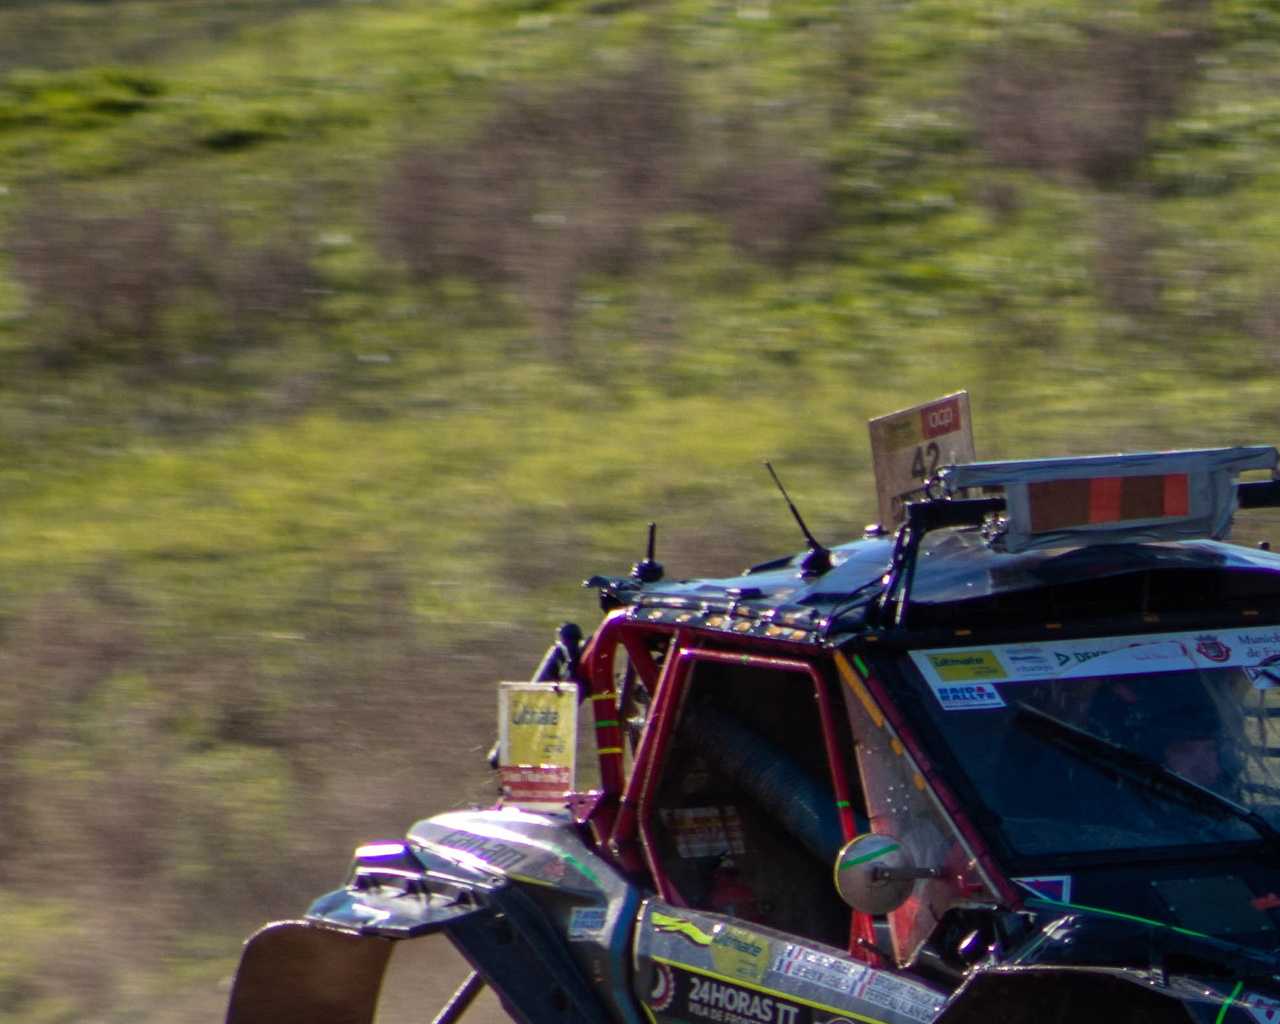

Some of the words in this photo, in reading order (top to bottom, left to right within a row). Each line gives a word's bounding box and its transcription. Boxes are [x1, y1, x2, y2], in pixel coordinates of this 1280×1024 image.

[911, 441, 940, 479] 42
[1246, 646, 1262, 658] de
[688, 977, 774, 1022] 24HORAS
[709, 1008, 725, 1022] DE
